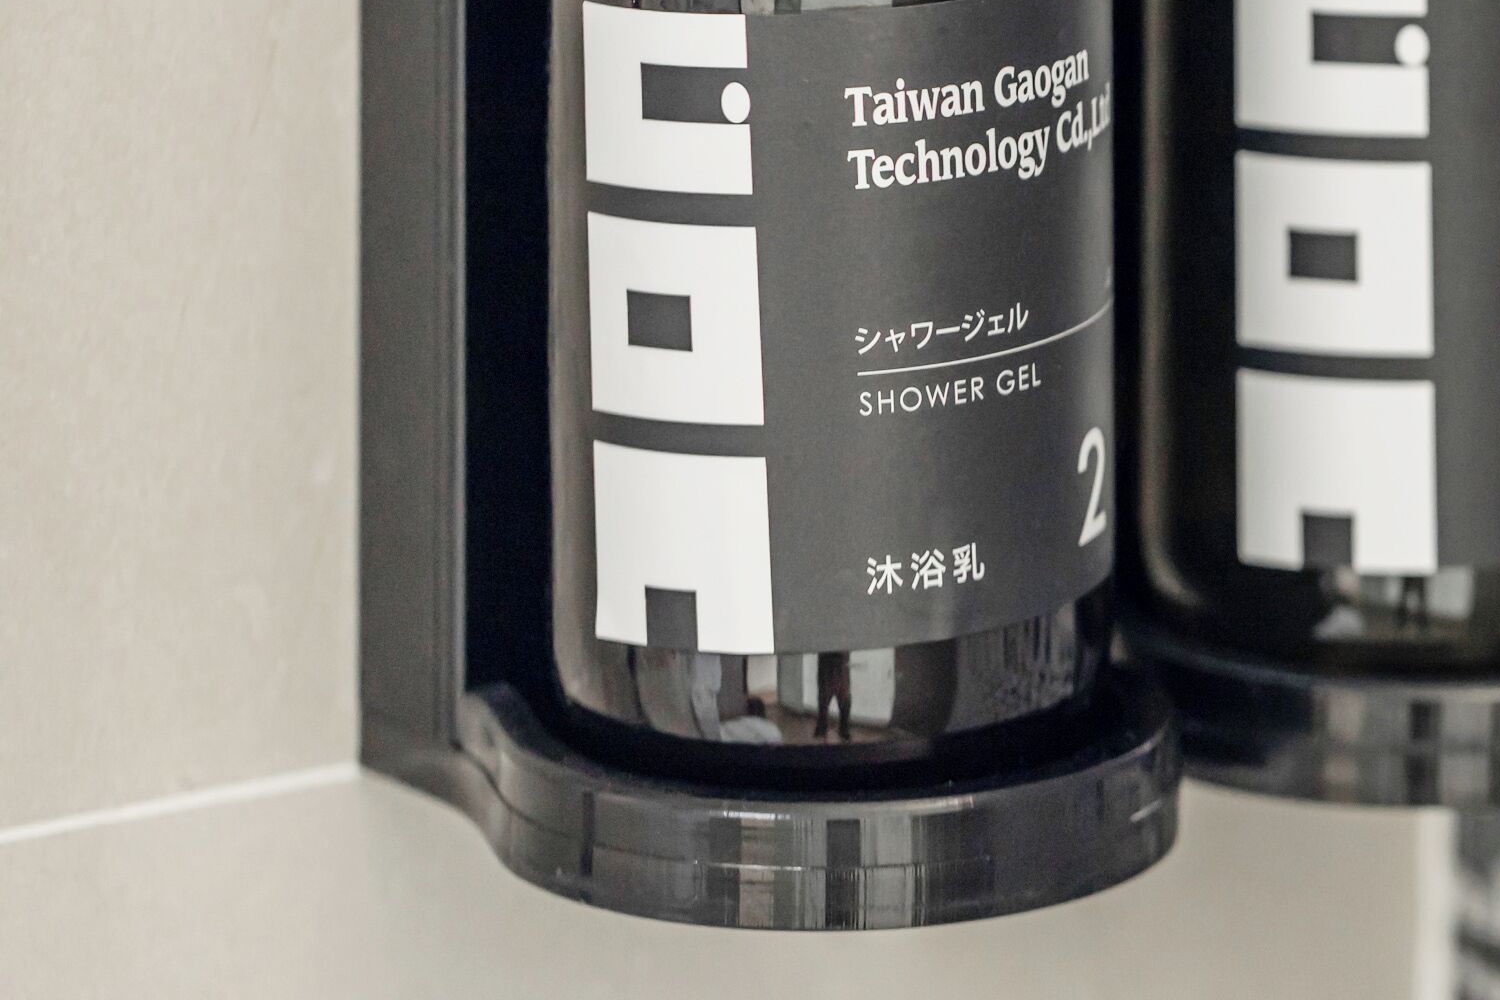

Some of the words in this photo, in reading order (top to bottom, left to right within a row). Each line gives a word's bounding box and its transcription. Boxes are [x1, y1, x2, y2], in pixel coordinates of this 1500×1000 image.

[844, 77, 985, 127] Taiwan
[994, 49, 1090, 108] Gaogan
[847, 125, 1050, 190] Technology
[855, 302, 1029, 355] シャワージェル
[859, 376, 984, 417] SHOWER
[996, 362, 1042, 396] GEL
[1077, 426, 1107, 547] 2
[866, 542, 985, 596] 沐浴乳
